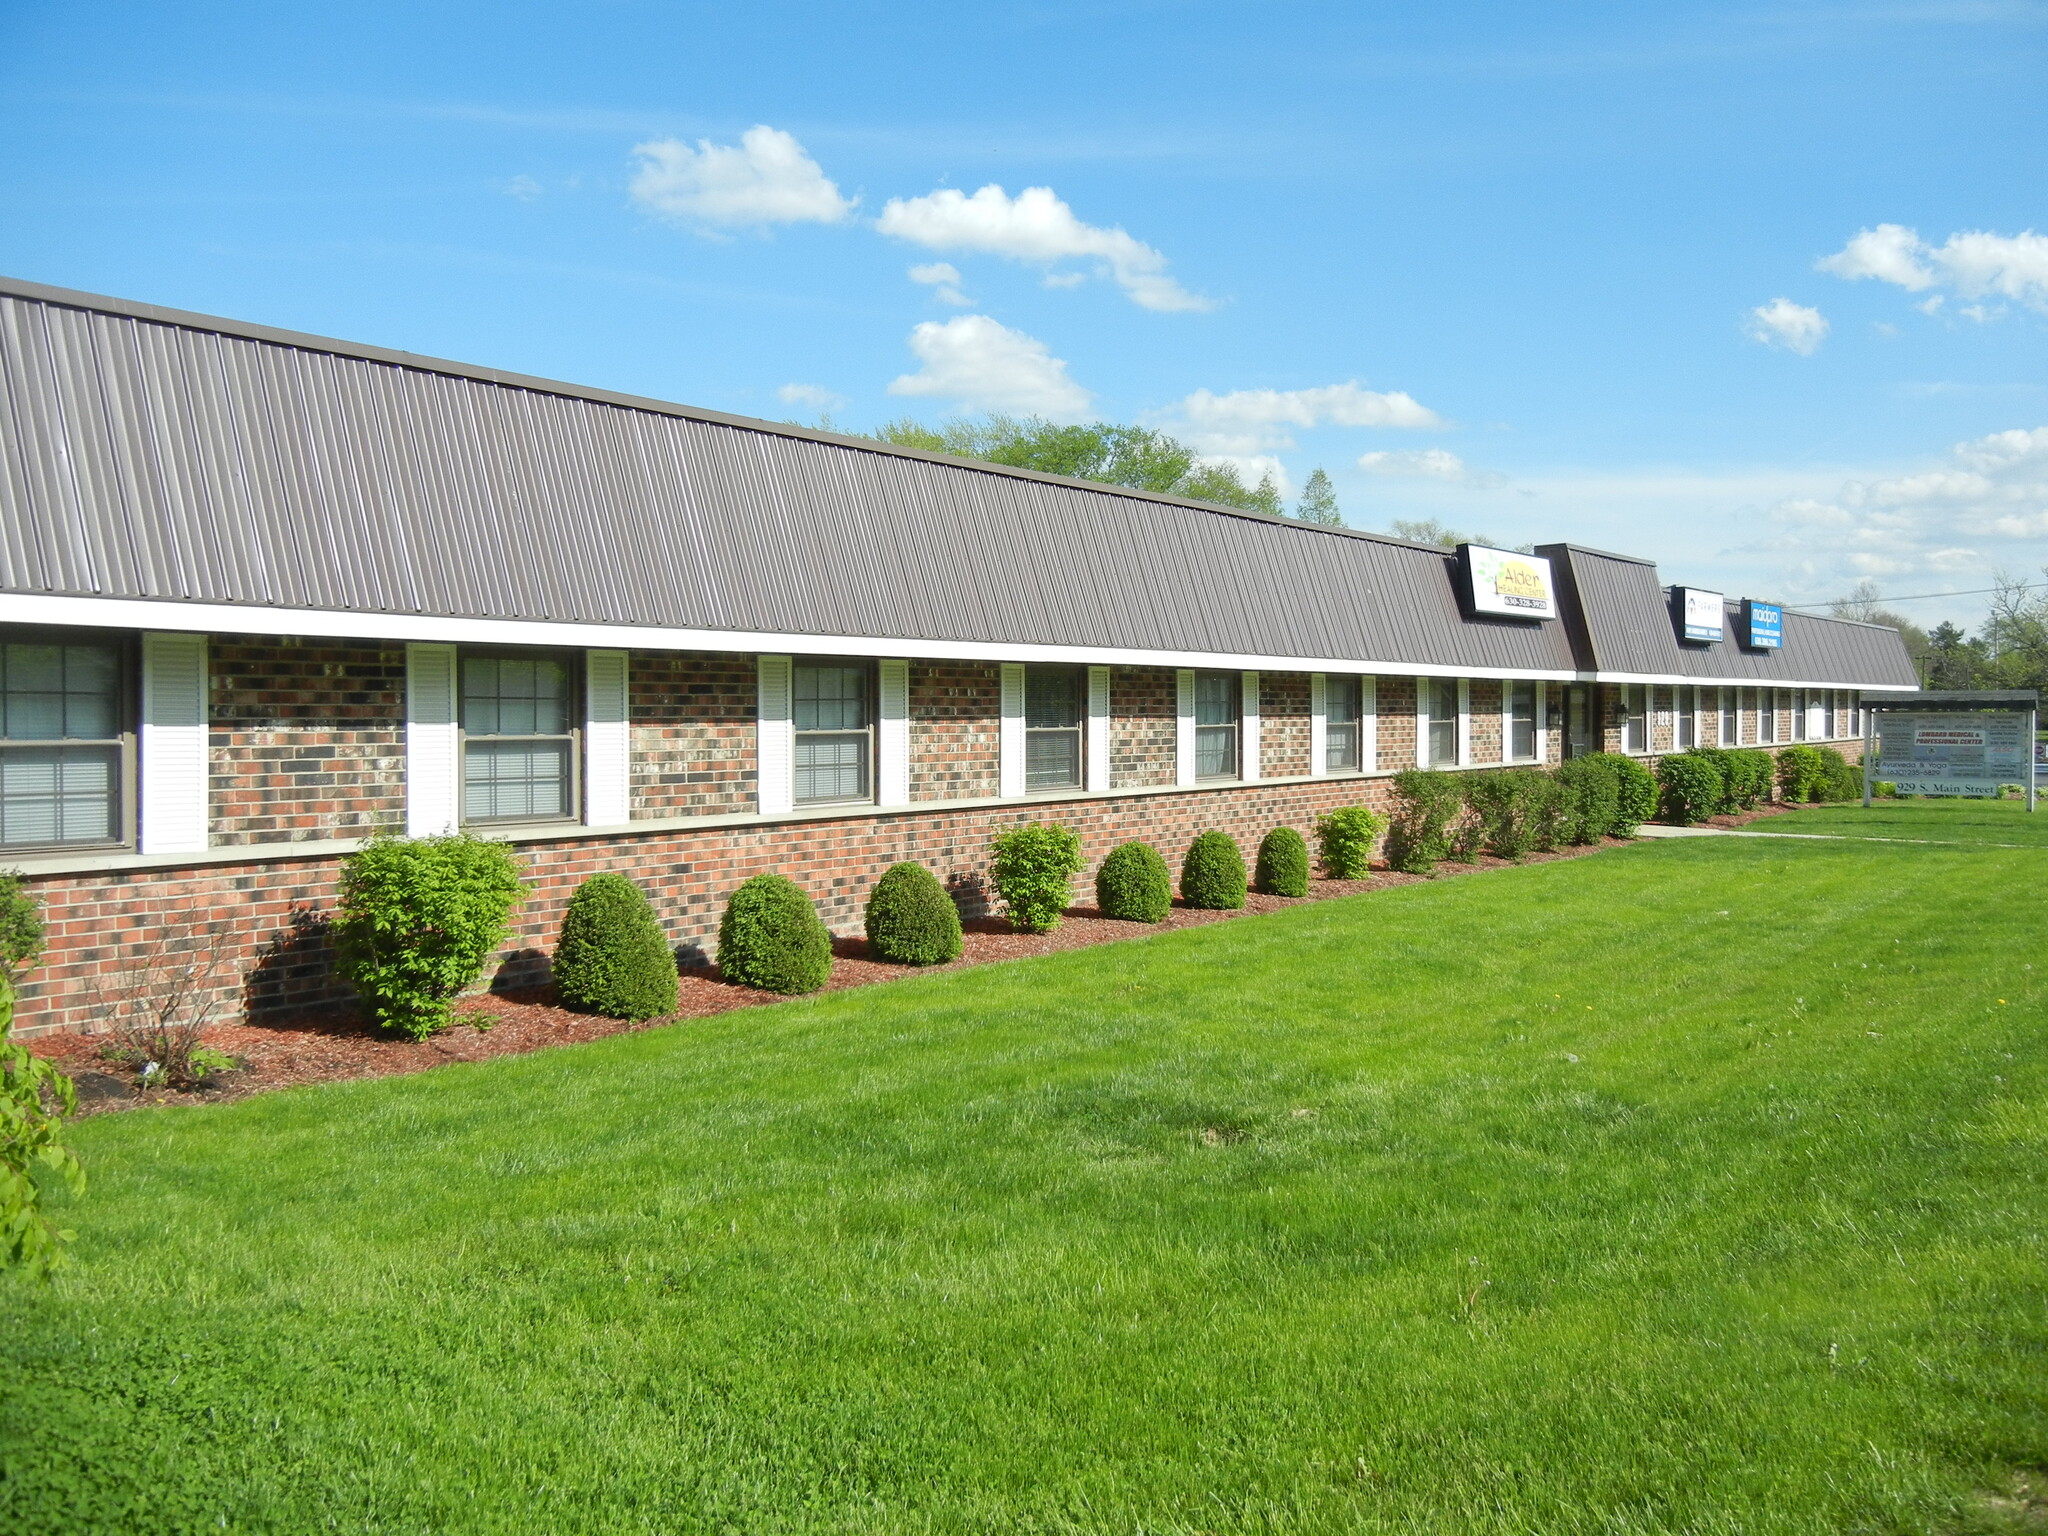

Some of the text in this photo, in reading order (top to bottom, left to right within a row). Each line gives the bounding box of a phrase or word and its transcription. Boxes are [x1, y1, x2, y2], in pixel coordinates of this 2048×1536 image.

[1505, 568, 1540, 587] Alder
[1498, 584, 1546, 599] HEALING CENTER
[1752, 605, 1778, 628] maidpro
[1897, 783, 1994, 794] 929 S. Main Street
